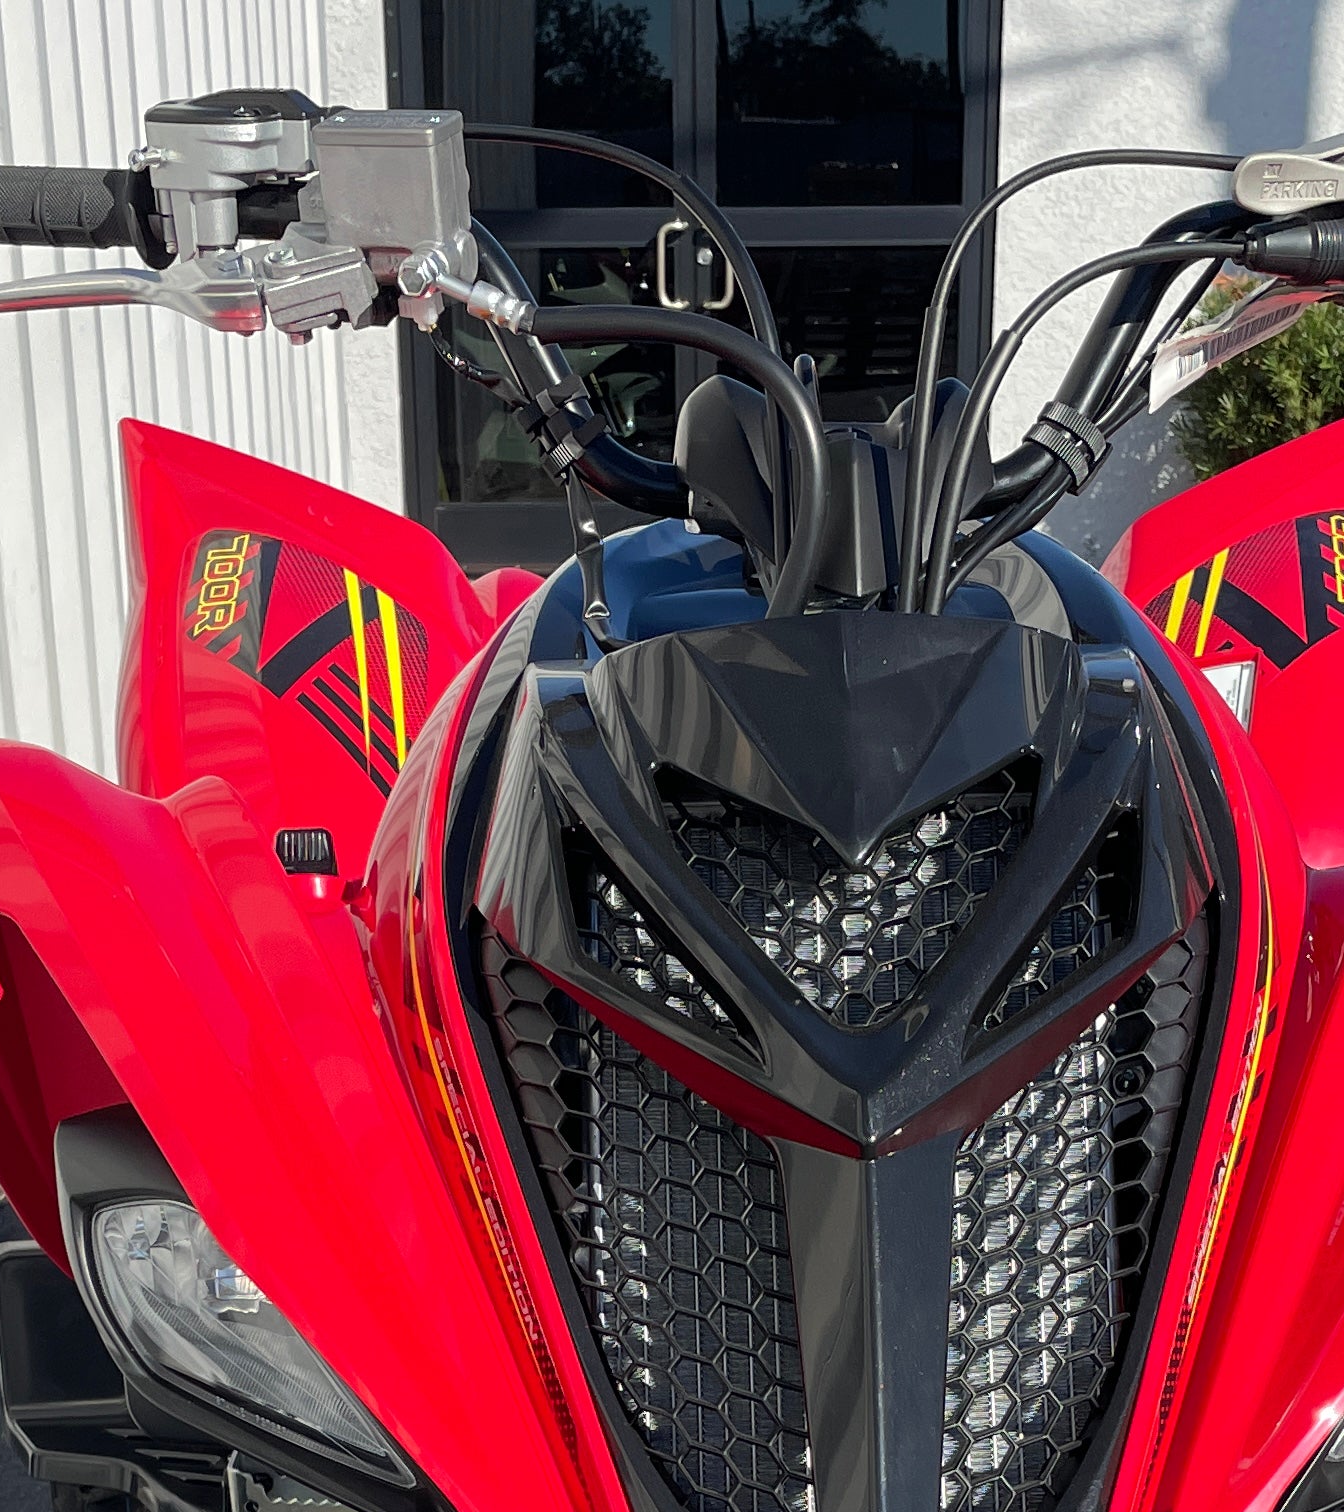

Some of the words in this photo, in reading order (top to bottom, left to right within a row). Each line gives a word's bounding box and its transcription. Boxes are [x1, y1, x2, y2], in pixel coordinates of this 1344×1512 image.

[1260, 180, 1338, 199] PARKING
[193, 533, 250, 637] 700R
[434, 1037, 484, 1192] SPECIAL
[484, 1197, 538, 1341] EDITION
